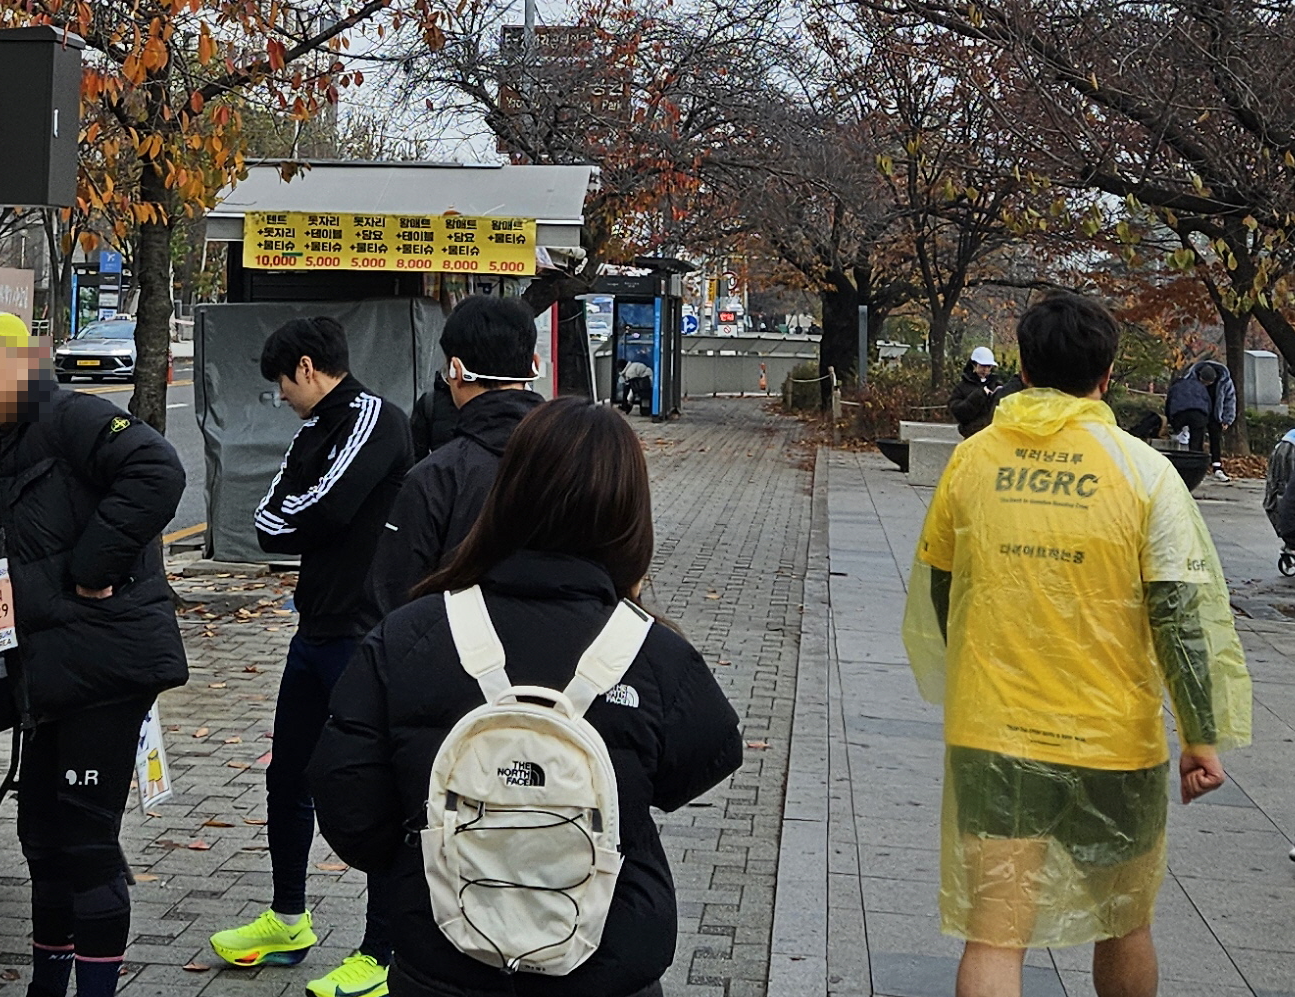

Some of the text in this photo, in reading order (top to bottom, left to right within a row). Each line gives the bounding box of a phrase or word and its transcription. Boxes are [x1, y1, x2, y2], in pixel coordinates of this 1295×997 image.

[256, 255, 297, 267] 10,000
[305, 256, 340, 268] 5,000
[351, 257, 386, 268] 5,000
[396, 259, 432, 270] 8,000
[442, 260, 478, 271] 8,000
[489, 261, 525, 272] 5,000
[995, 467, 1100, 498] BIGRC
[512, 760, 531, 770] THE
[497, 767, 531, 780] NORTH
[506, 777, 532, 787] FACE
